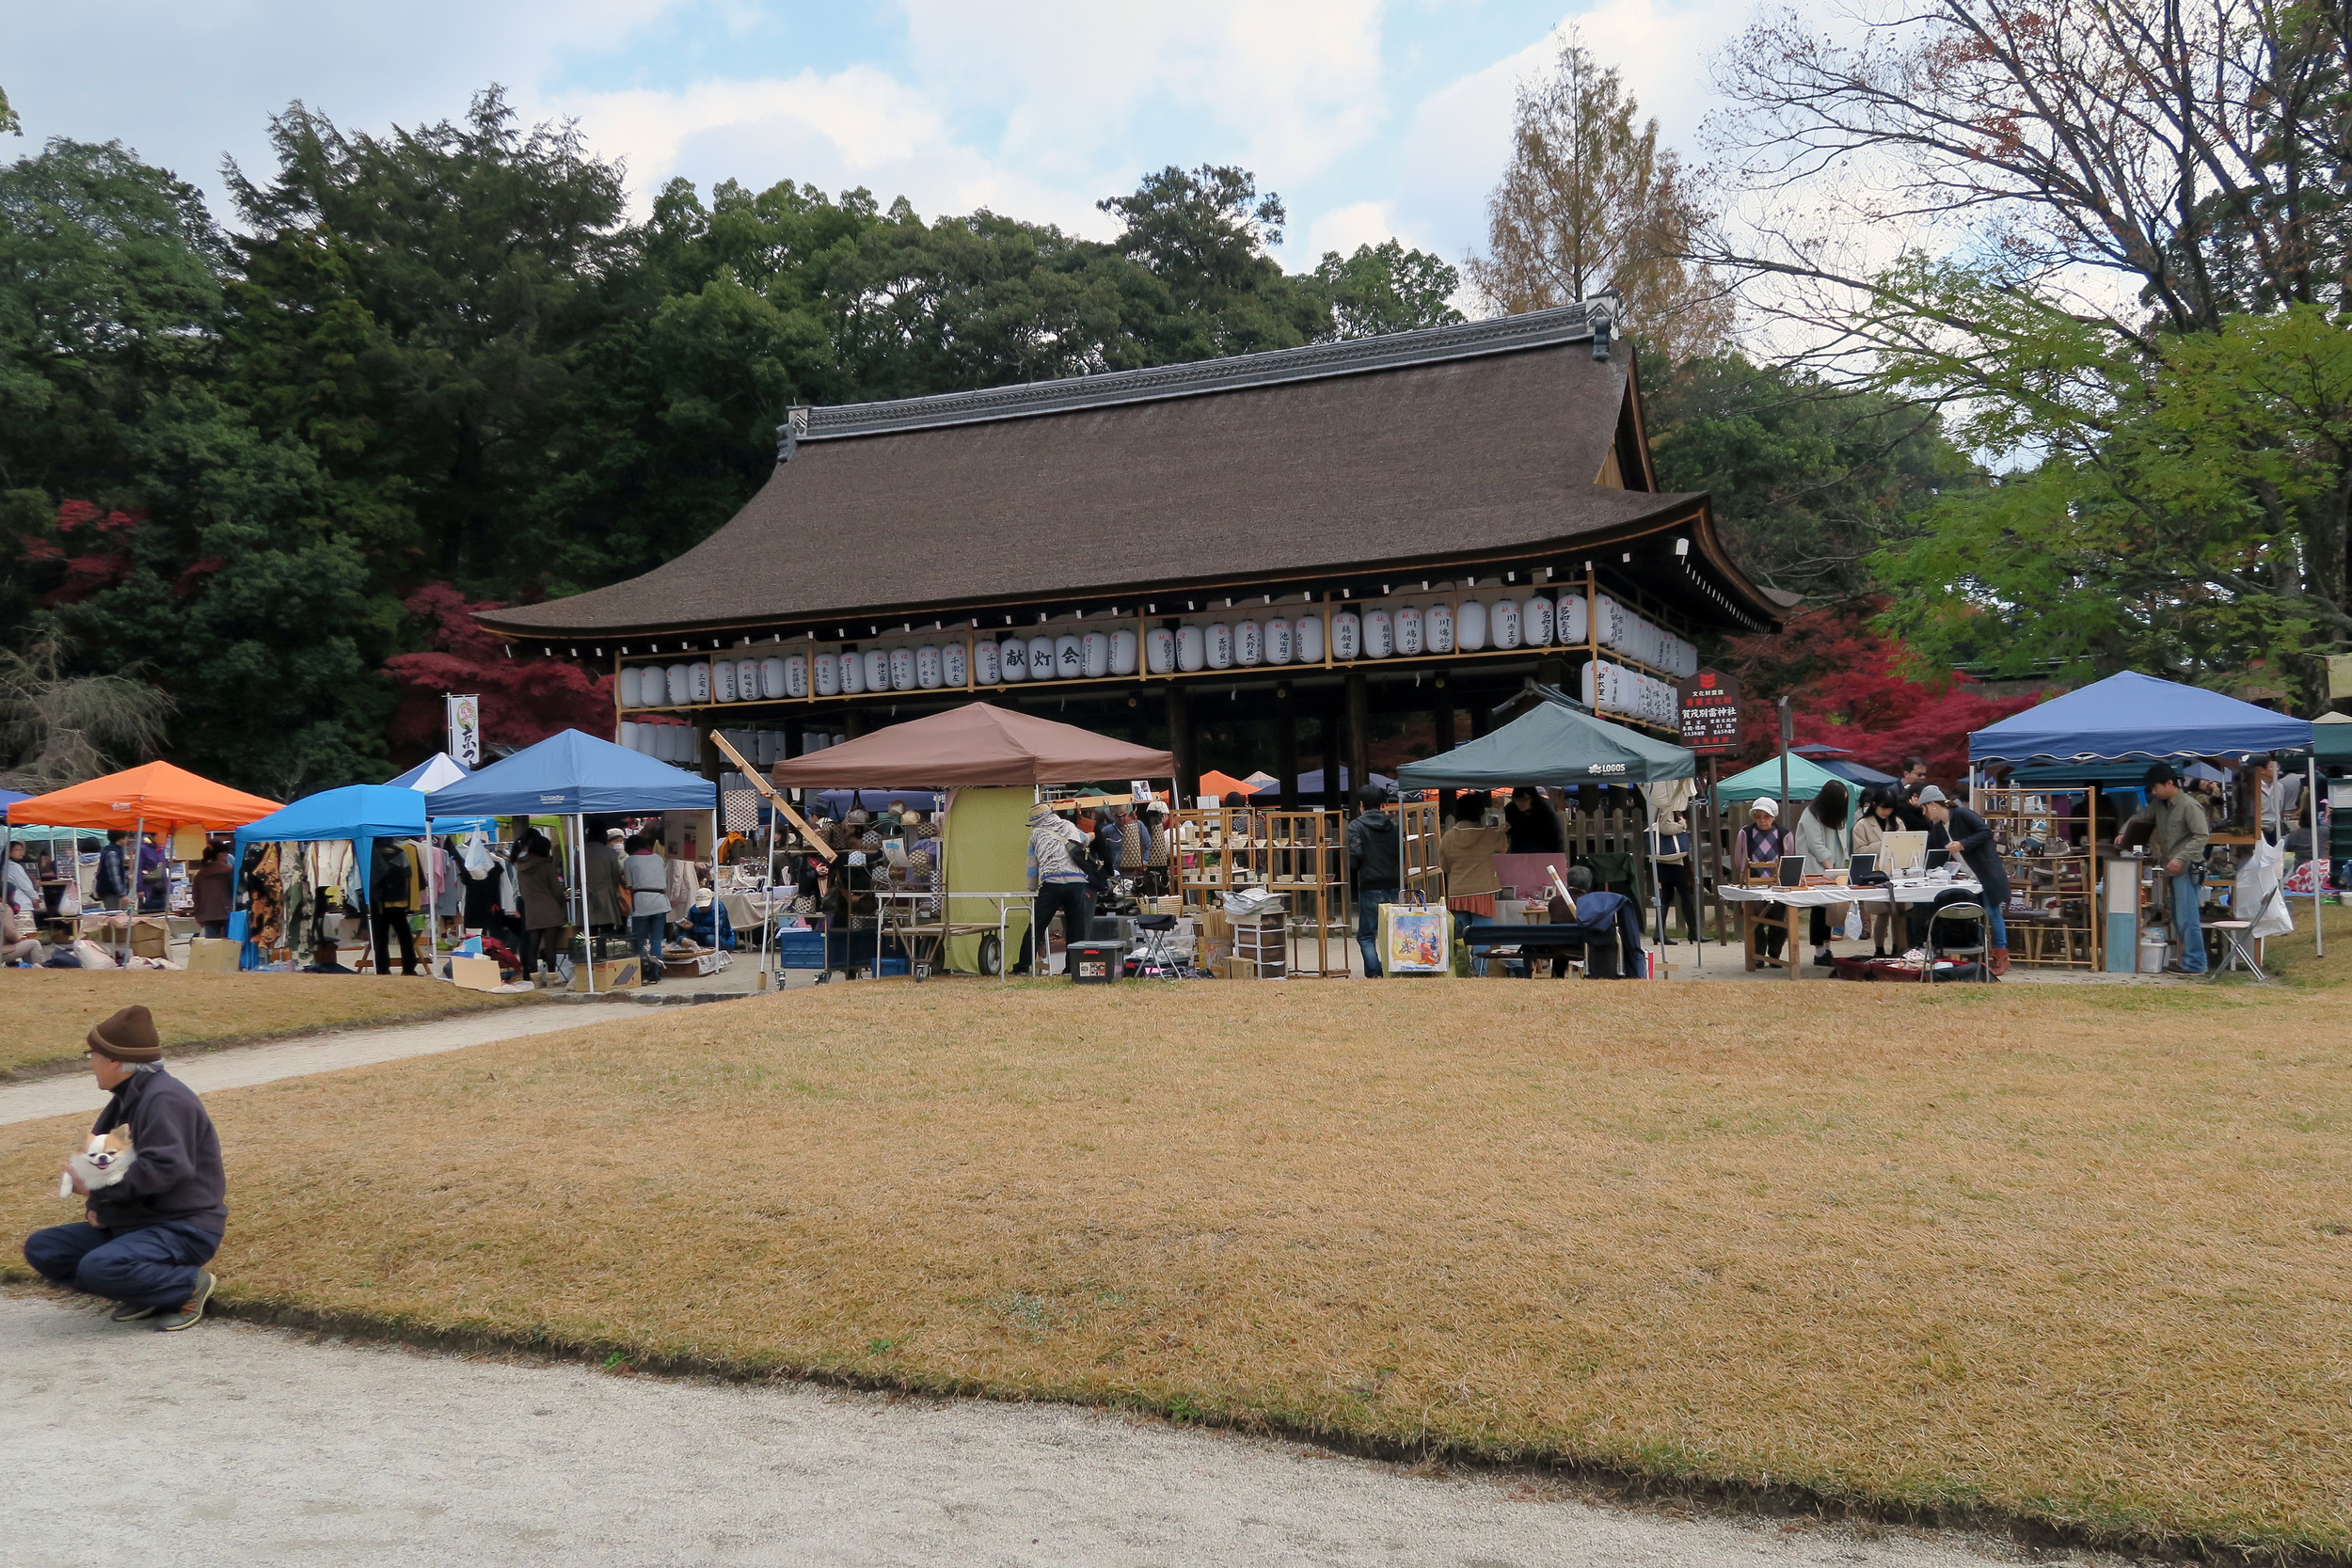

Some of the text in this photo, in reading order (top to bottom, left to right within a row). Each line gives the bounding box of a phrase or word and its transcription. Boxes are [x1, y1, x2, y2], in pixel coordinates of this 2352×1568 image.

[1681, 706, 1738, 720] 賀茂別雷神社
[1602, 763, 1626, 773] LOGOS
